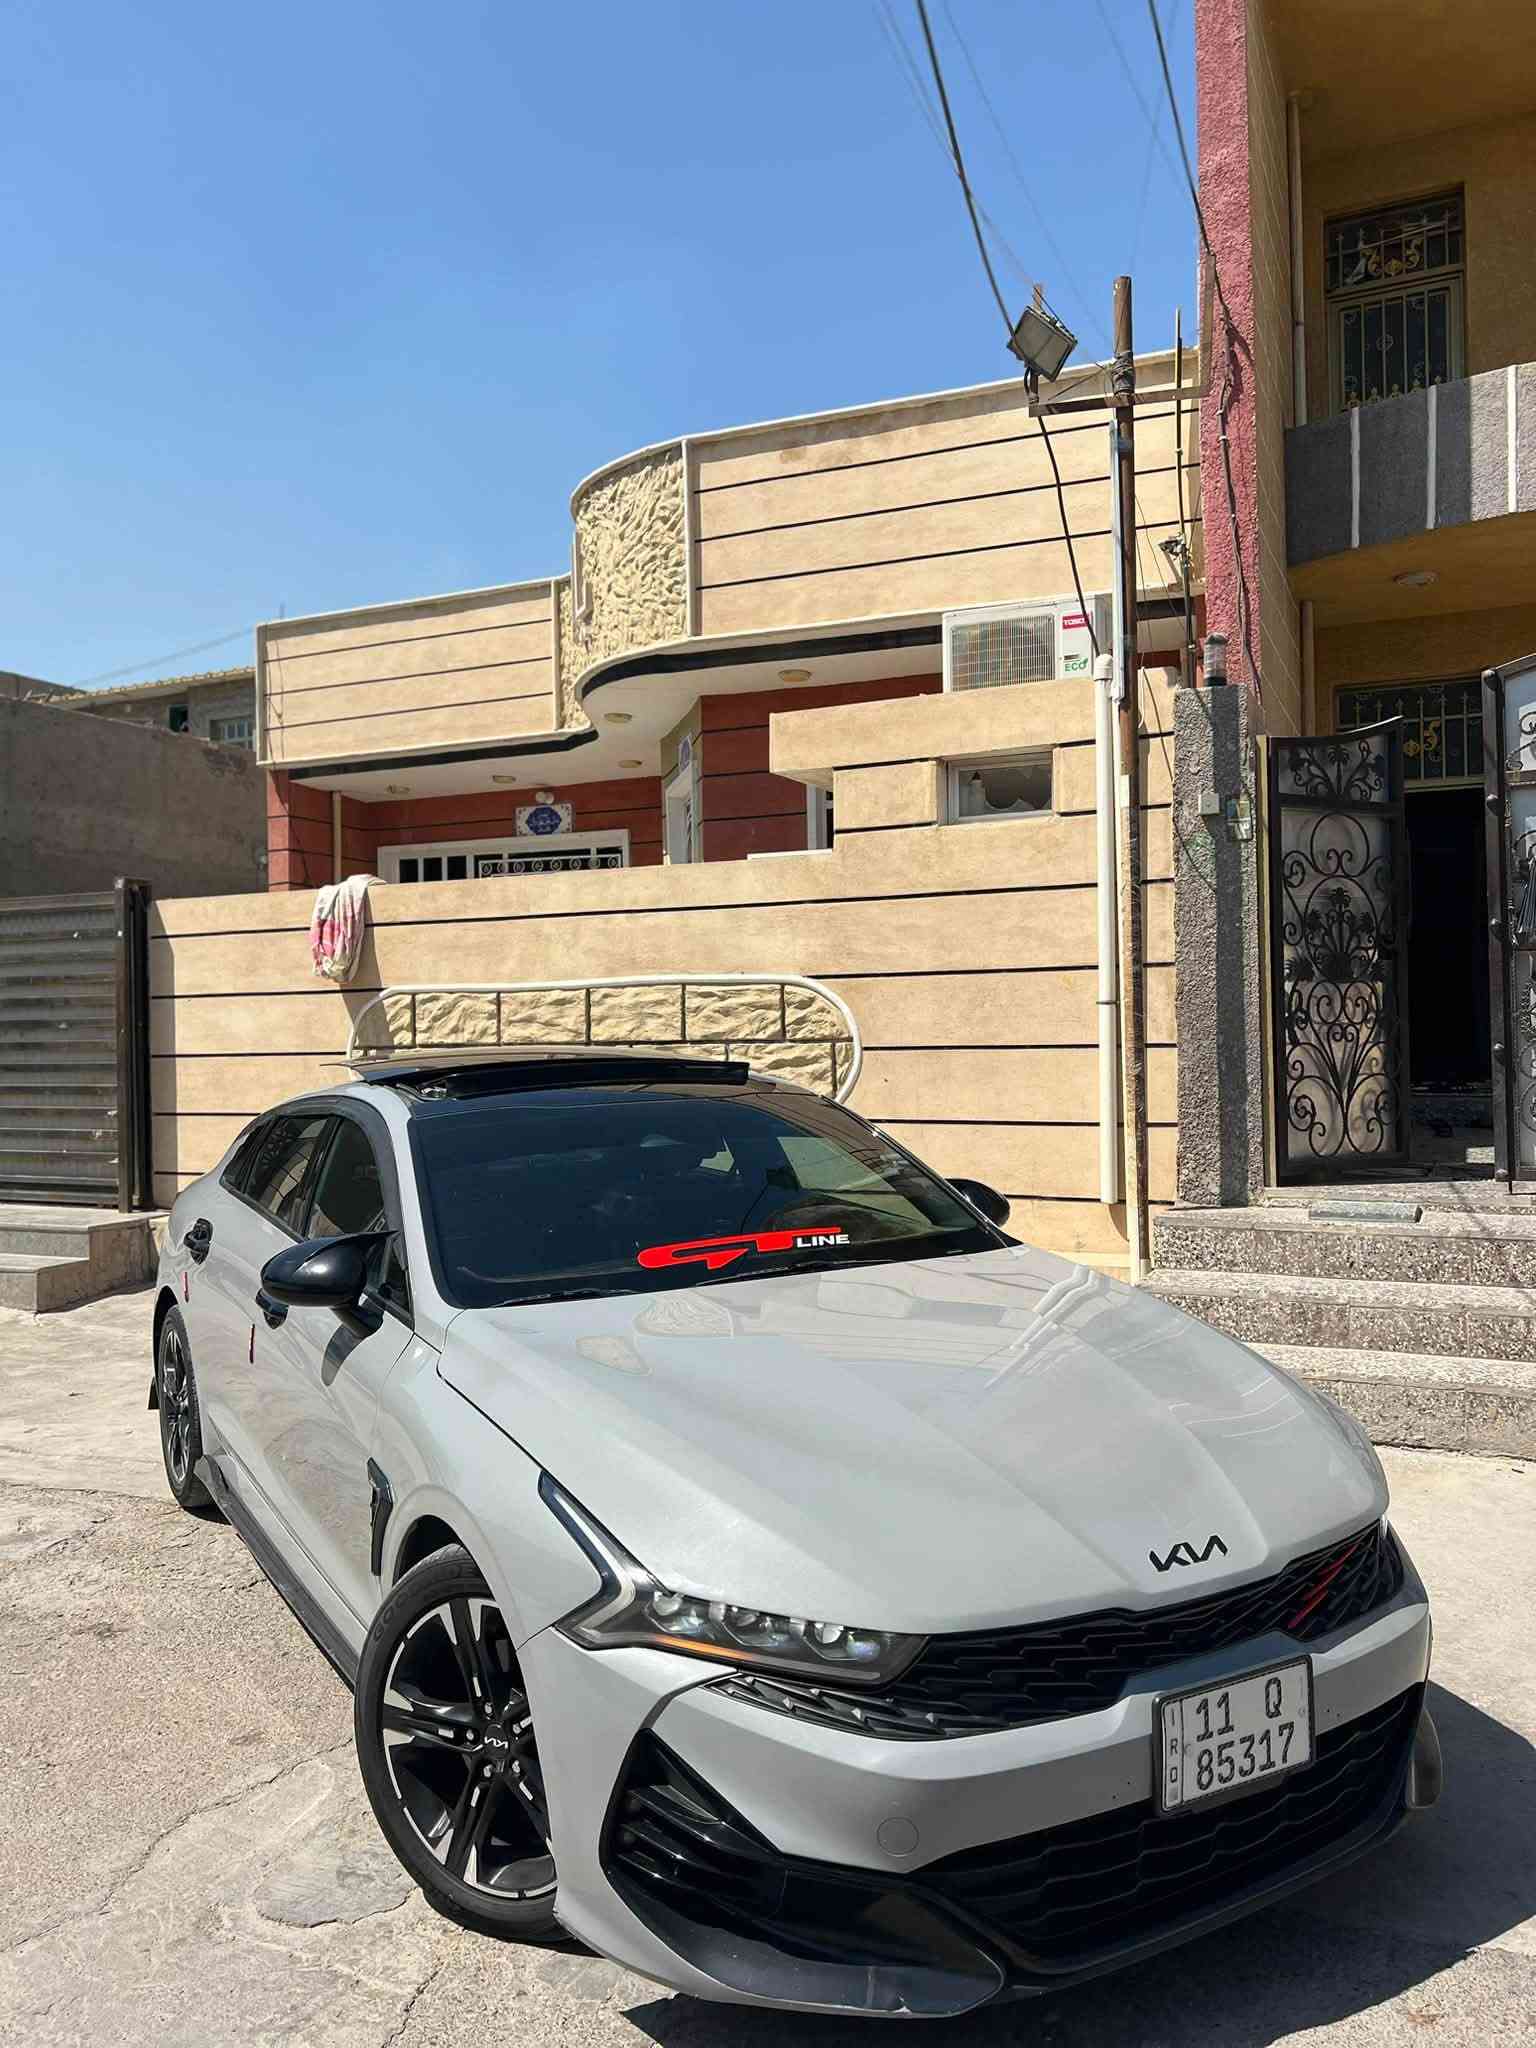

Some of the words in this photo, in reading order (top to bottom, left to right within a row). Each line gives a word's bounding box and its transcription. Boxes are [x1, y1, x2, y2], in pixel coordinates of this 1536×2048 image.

[1065, 660, 1087, 671] ECO
[637, 1226, 841, 1270] GT
[796, 1234, 850, 1248] LINE
[1149, 1535, 1228, 1572] KIA
[1196, 1691, 1235, 1742] 11
[1264, 1677, 1282, 1719] Q
[1196, 1721, 1295, 1791] 85317
